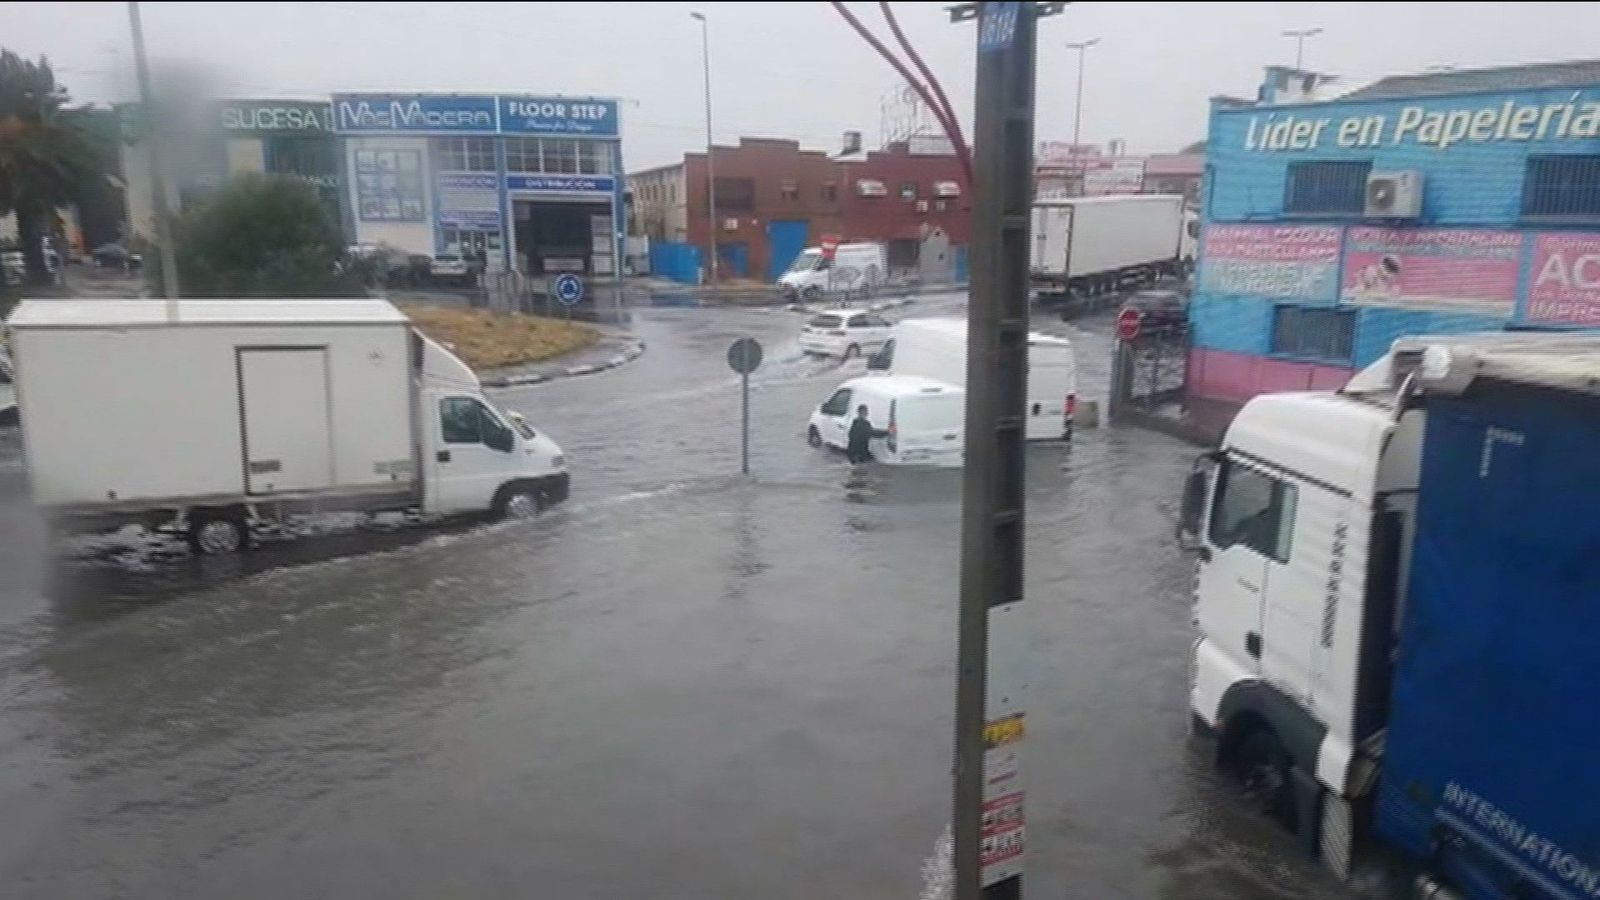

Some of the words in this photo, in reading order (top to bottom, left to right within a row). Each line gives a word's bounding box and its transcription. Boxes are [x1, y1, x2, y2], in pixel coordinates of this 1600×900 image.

[221, 107, 320, 130] SUCESA
[508, 101, 566, 118] FLOOR
[571, 104, 608, 120] STEP
[1244, 112, 1331, 152] Líder
[1337, 115, 1386, 148] en
[1394, 91, 1600, 149] Papelería
[1442, 779, 1600, 900] INTERNATION
